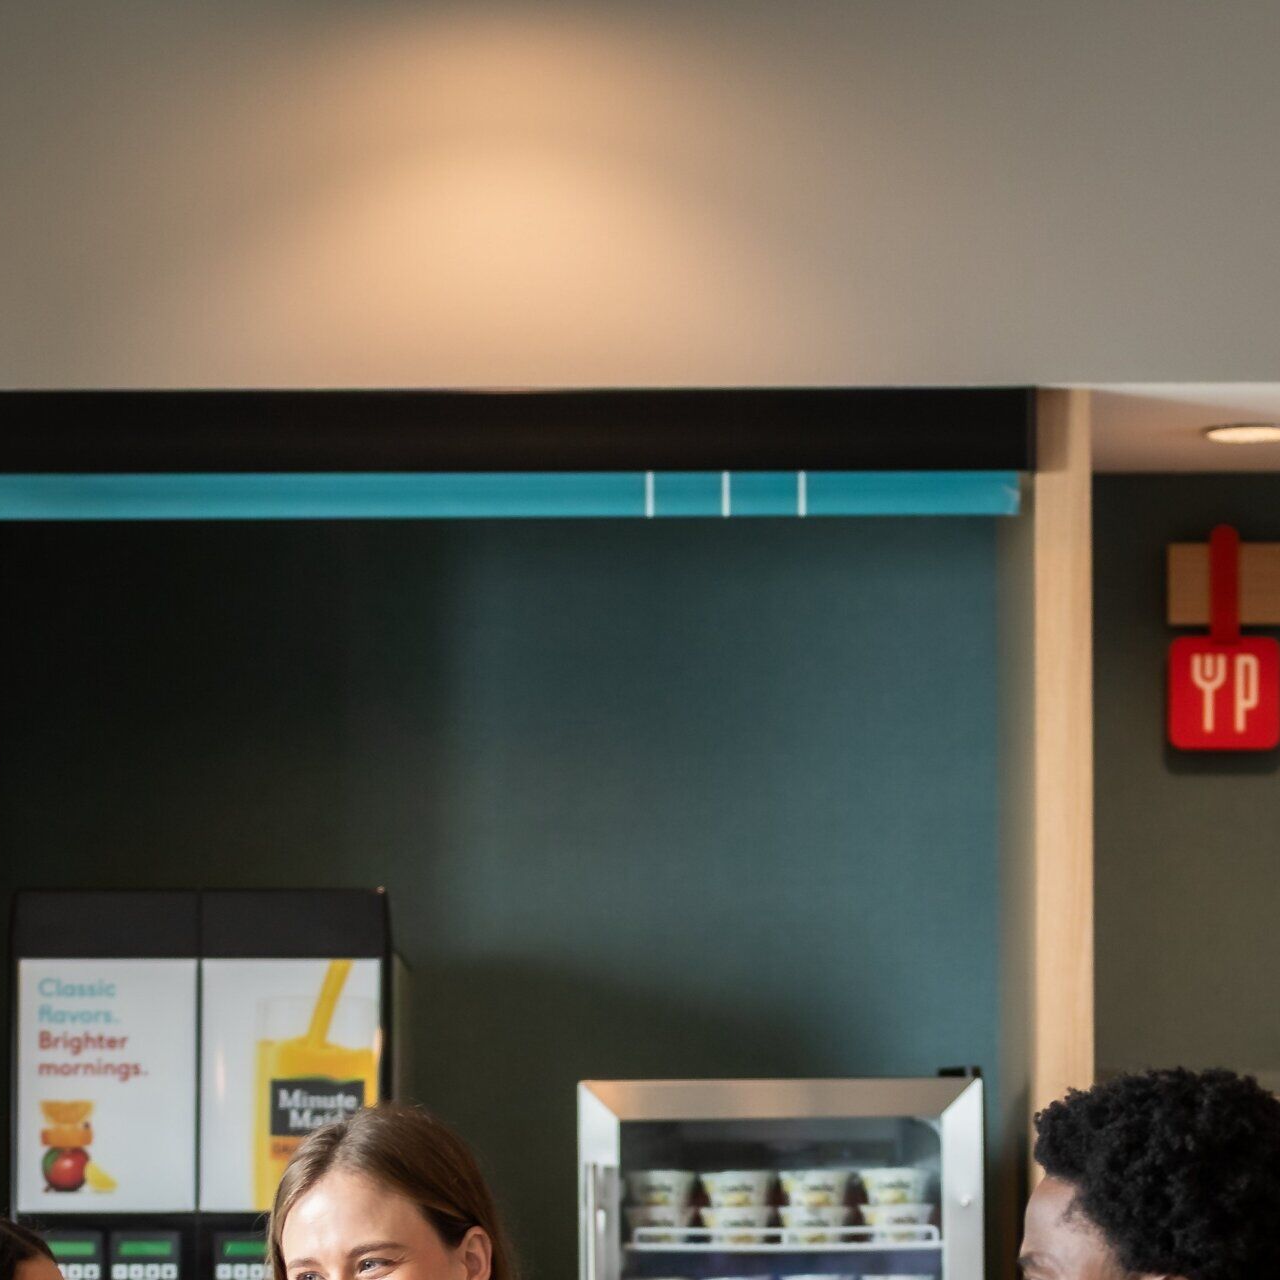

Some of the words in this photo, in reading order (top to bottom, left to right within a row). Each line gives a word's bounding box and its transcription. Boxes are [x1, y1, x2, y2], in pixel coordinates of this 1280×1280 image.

[37, 977, 117, 998] Classic
[37, 1003, 121, 1024] flavors.
[38, 1029, 129, 1056] Brighter
[37, 1057, 149, 1083] mornings.
[278, 1088, 358, 1109] Minute
